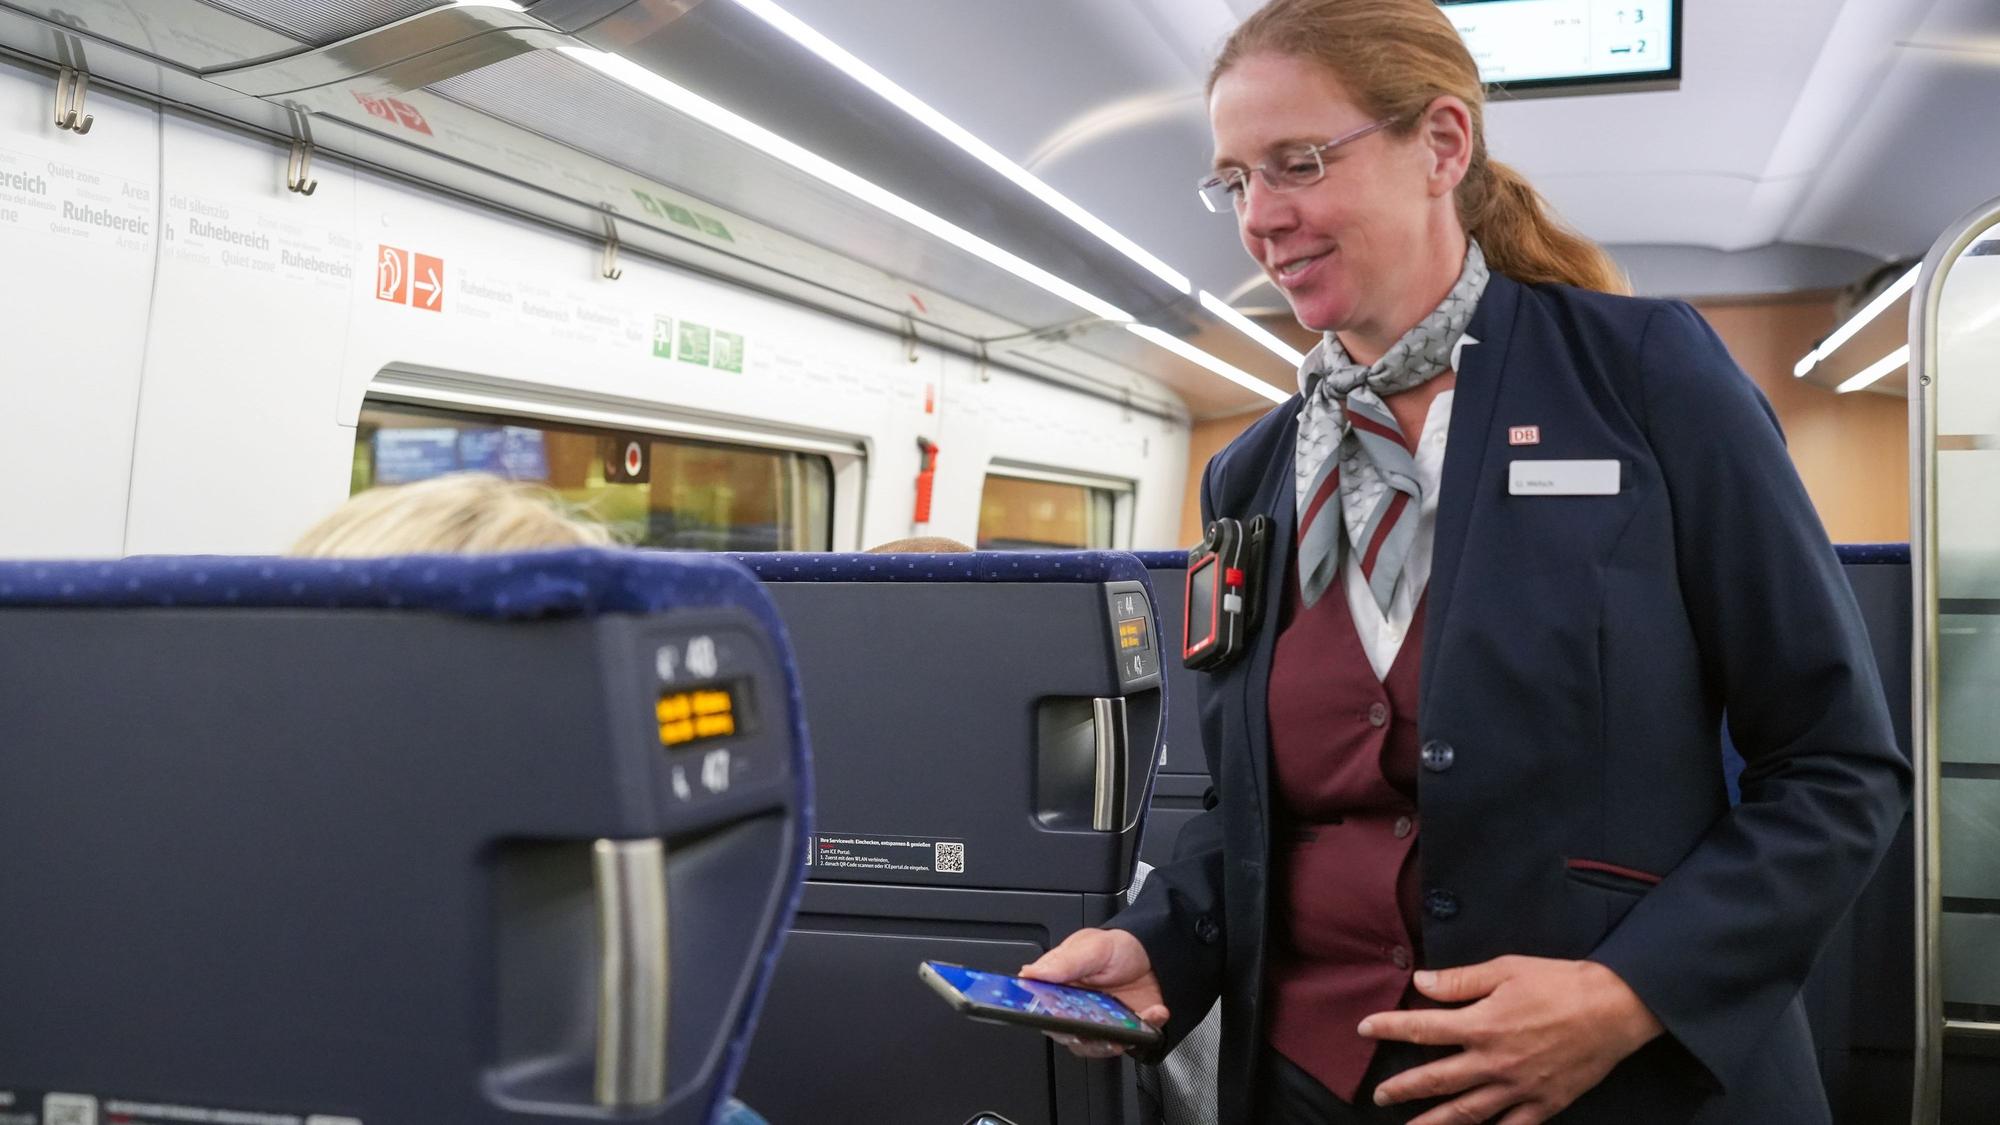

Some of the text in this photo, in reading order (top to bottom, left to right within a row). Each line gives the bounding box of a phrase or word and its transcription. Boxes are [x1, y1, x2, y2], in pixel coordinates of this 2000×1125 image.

[1633, 8, 1644, 23] 3
[1636, 39, 1647, 54] 2
[47, 161, 101, 186] Quiet zone
[121, 182, 150, 201] Area
[189, 217, 270, 251] Ruhebereich
[221, 249, 250, 268] Quiet
[280, 249, 353, 280] Ruhebereich
[1514, 430, 1535, 441] DB
